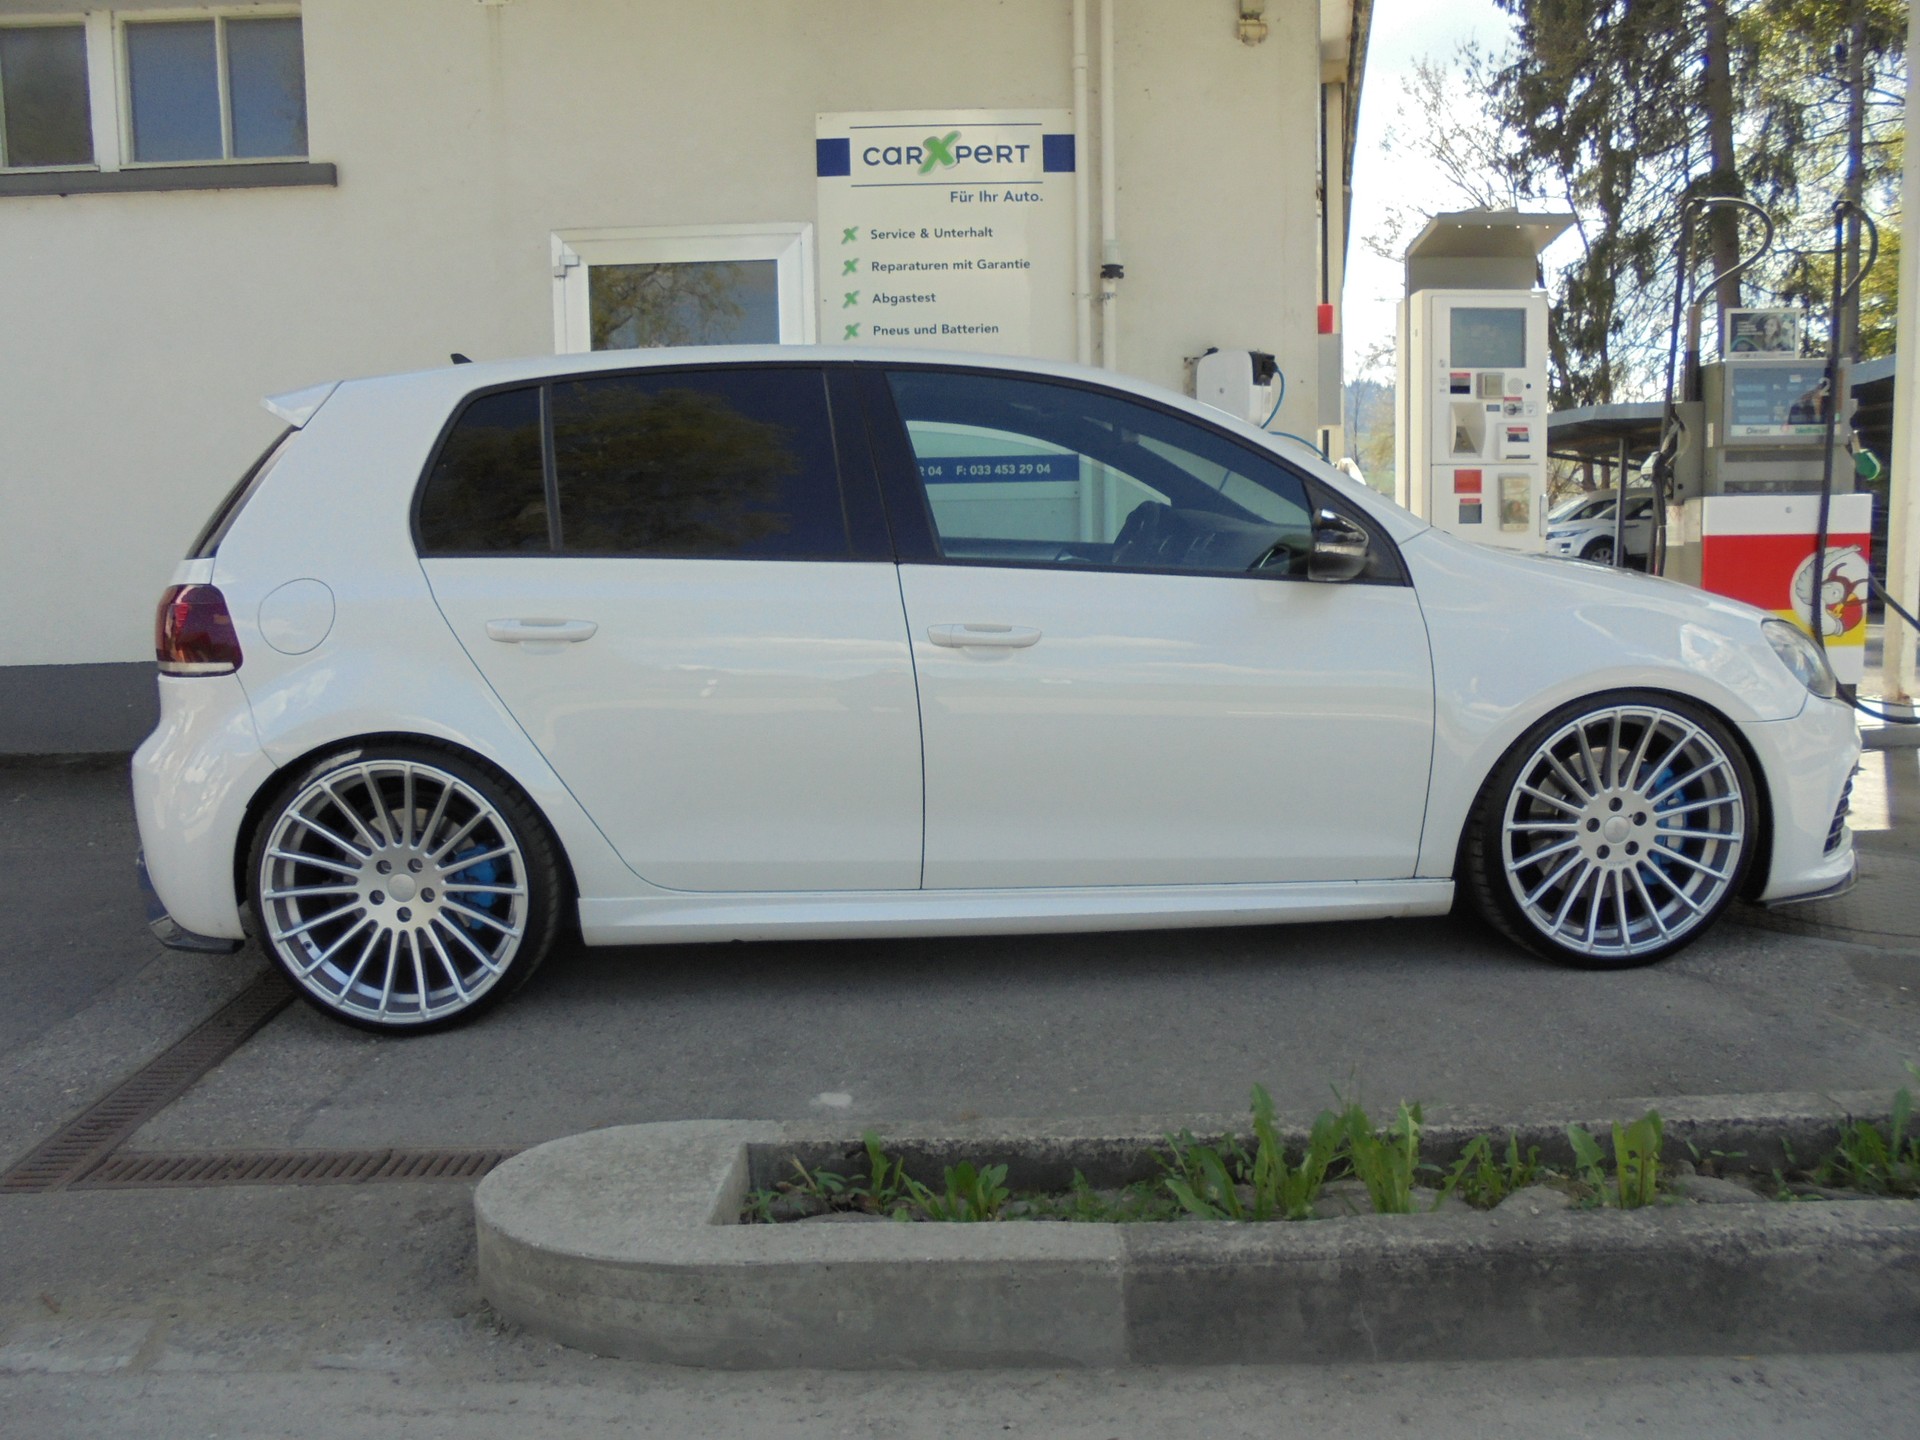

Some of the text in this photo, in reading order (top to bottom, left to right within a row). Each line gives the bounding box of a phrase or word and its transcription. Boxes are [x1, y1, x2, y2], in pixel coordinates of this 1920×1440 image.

[950, 190, 1043, 203] Für Ihr Auto.
[870, 226, 993, 240] Service & Unterhalt
[871, 258, 1031, 274] Reparaturen mit Garantie
[872, 292, 936, 306] Abgastest
[873, 323, 999, 336] Pneus und Batterien
[927, 465, 943, 477] 04
[956, 465, 967, 476] F:
[969, 464, 991, 476] 033
[994, 463, 1016, 475] 453
[1018, 463, 1033, 475] 29
[1036, 463, 1051, 474] 04
